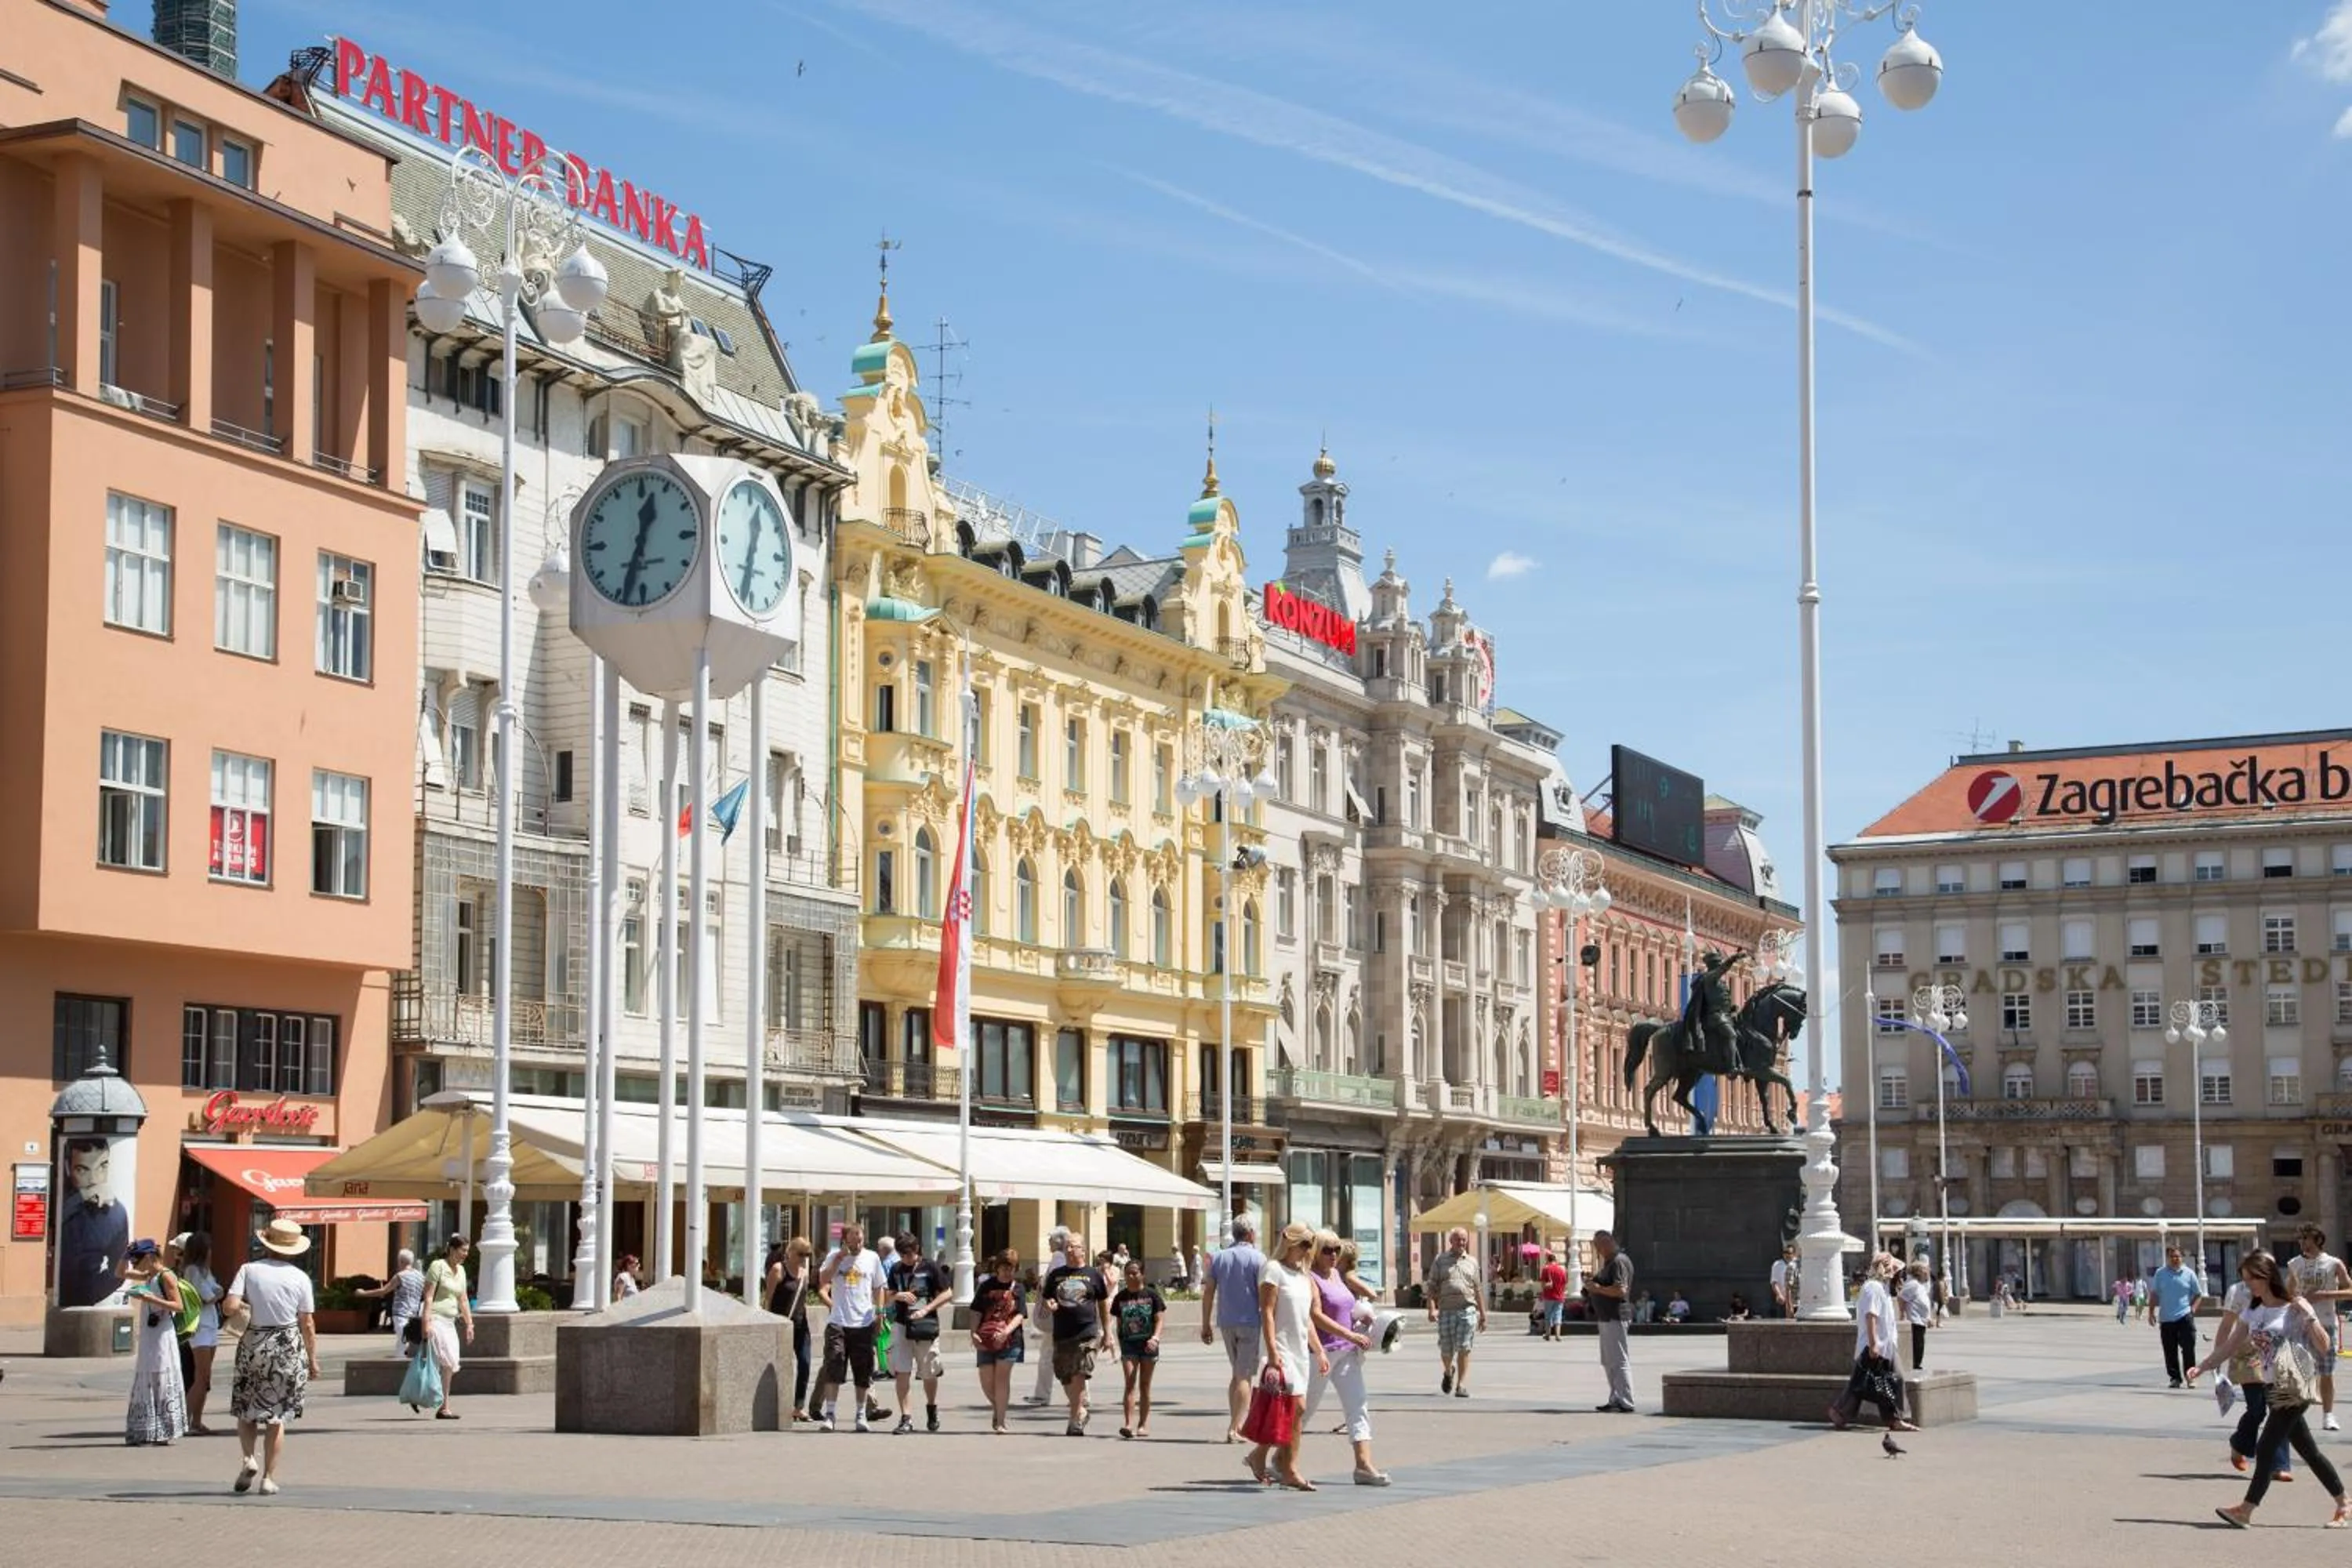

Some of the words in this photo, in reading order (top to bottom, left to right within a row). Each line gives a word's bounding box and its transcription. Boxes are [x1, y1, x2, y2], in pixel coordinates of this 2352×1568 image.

[336, 35, 551, 191] PARTNER
[564, 151, 709, 270] BANKA
[1263, 581, 1356, 656] KONZUM
[2036, 755, 2307, 826] Zagrebačka
[1908, 965, 2125, 996] GRADSKA
